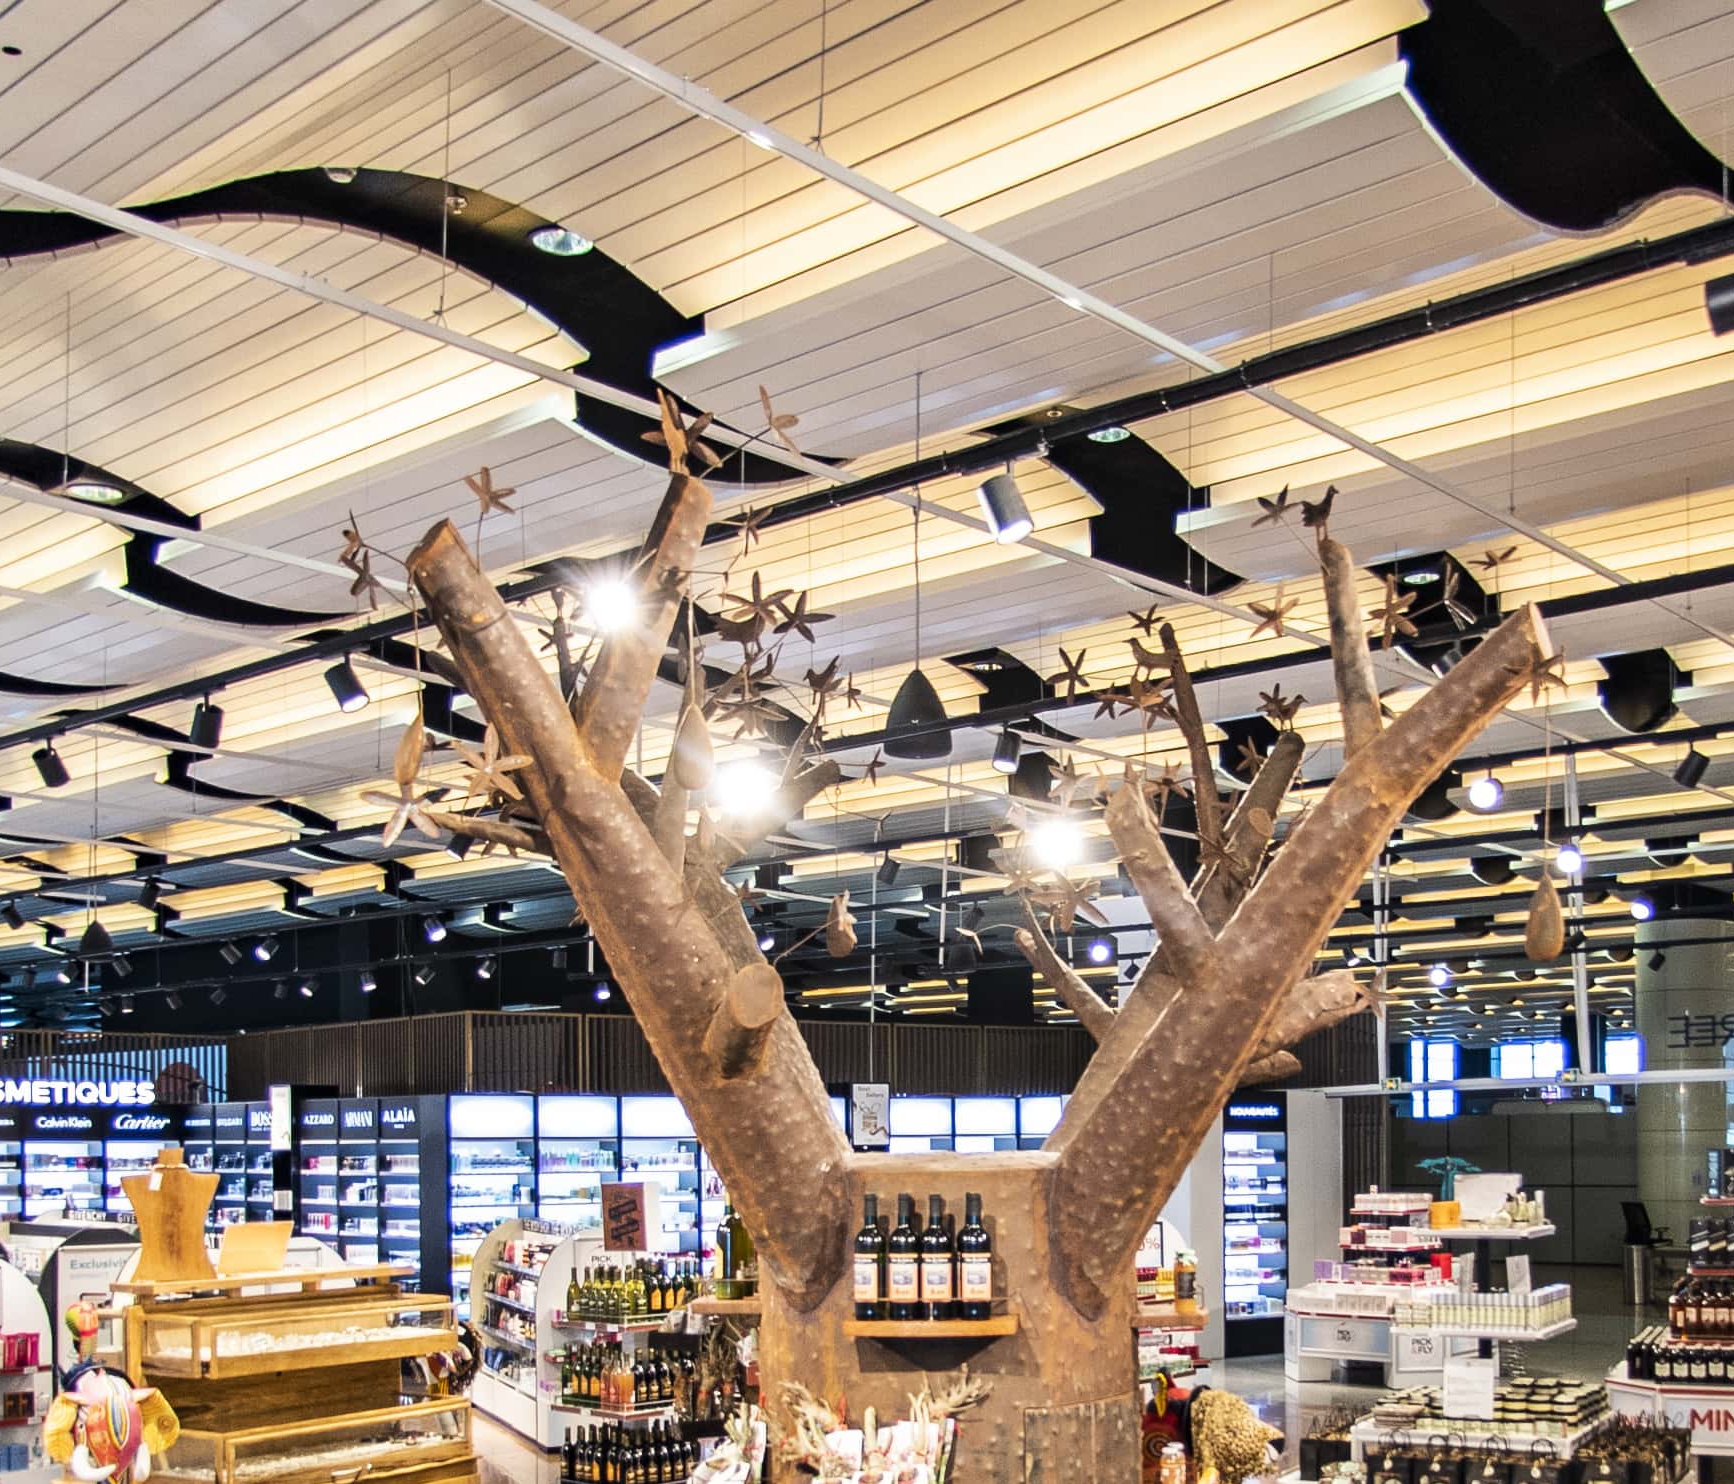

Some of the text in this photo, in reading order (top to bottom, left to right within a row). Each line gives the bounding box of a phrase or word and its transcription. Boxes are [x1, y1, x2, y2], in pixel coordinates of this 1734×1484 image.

[116, 1113, 171, 1130] Cartier
[303, 1114, 334, 1125] AZZARO
[383, 1107, 416, 1123] ALAÏA
